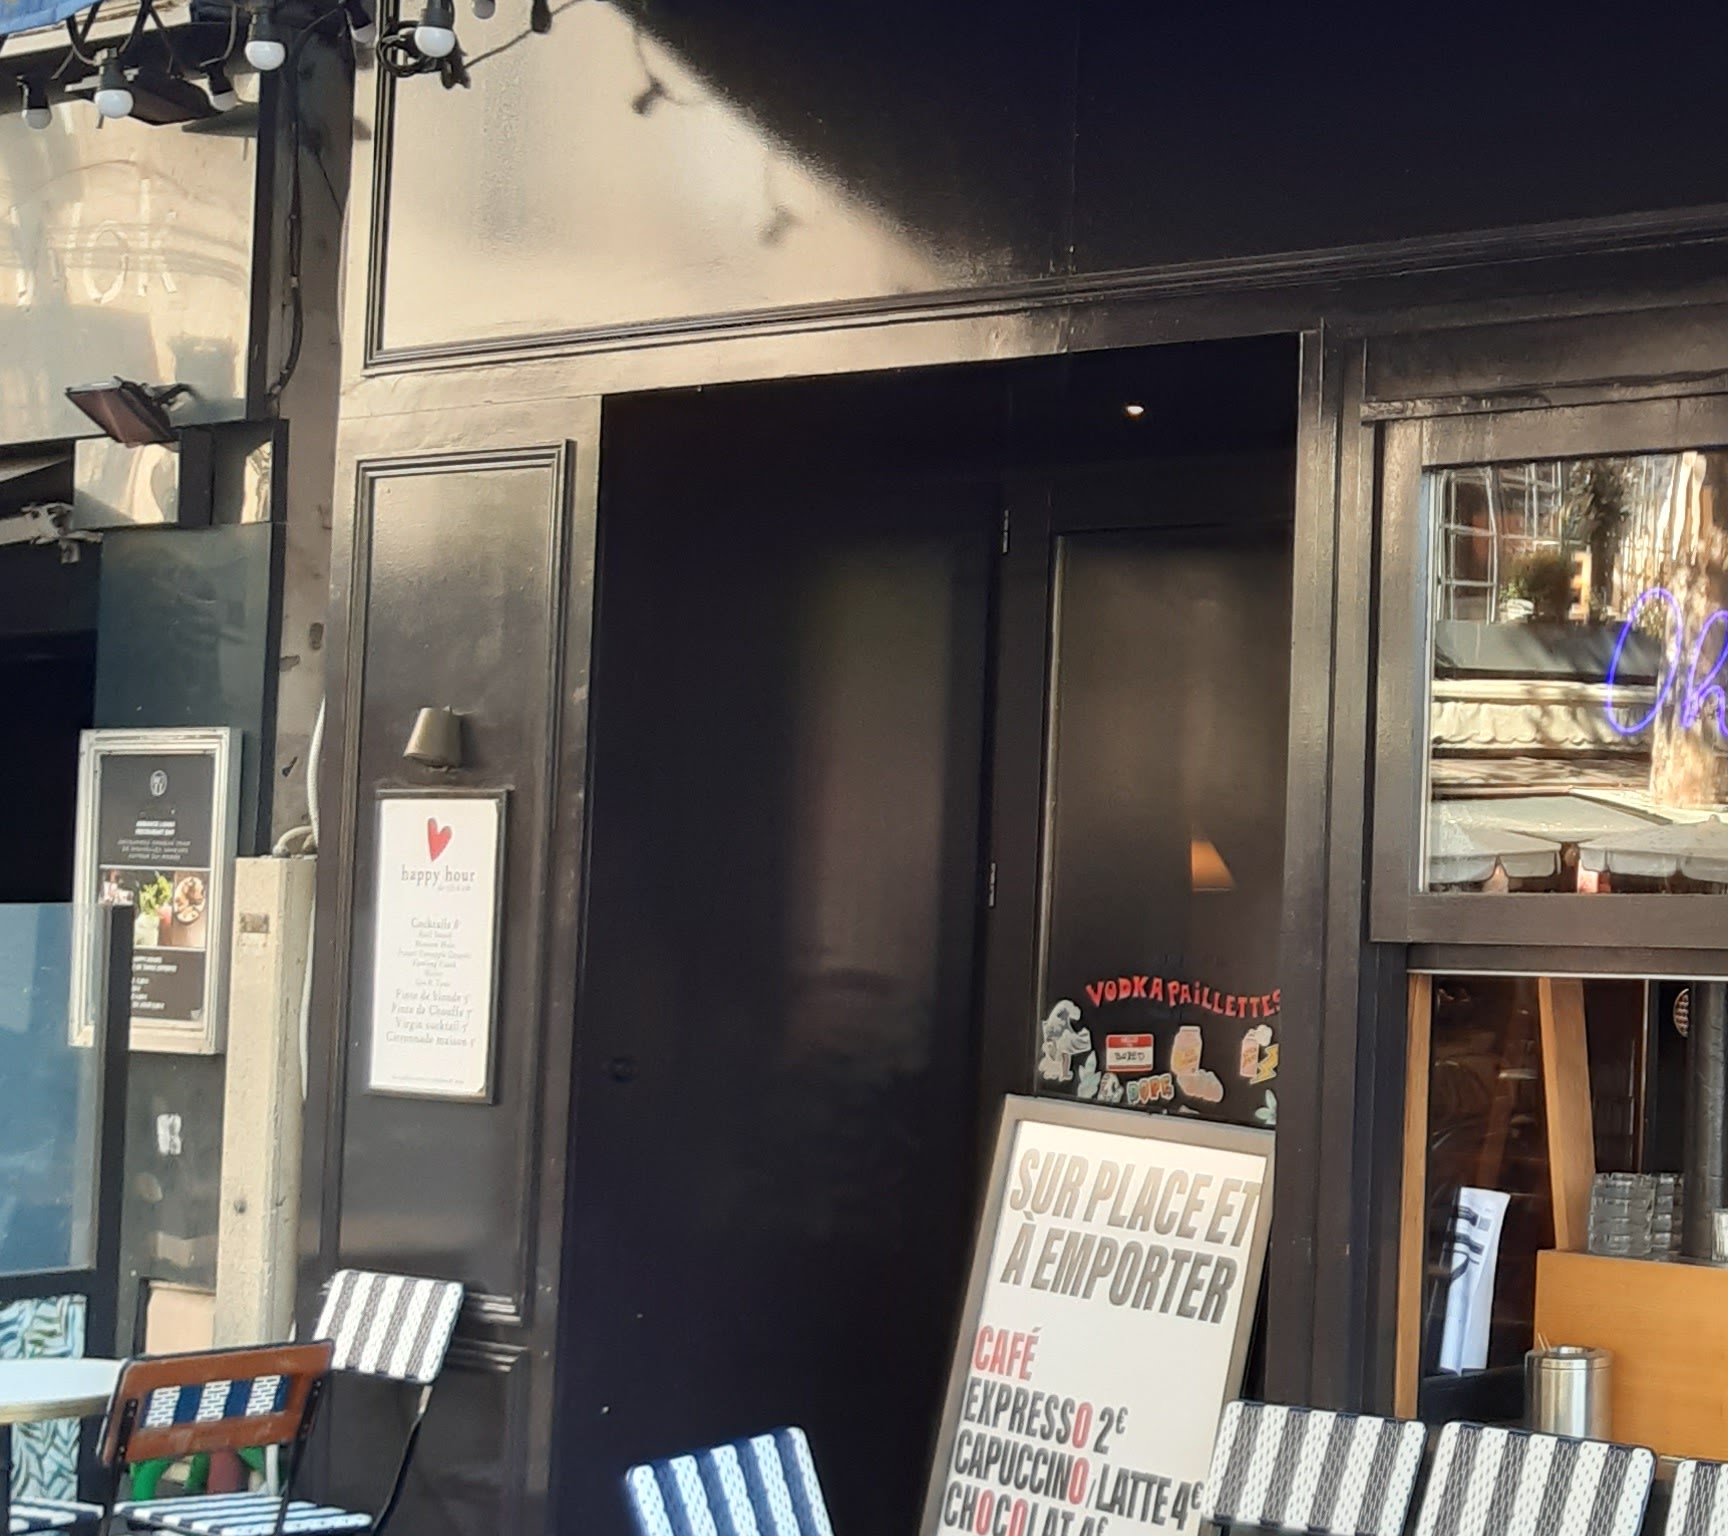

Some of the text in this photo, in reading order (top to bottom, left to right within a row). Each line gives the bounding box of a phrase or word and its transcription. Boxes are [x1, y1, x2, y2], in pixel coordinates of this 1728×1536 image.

[401, 865, 476, 886] happy hour
[1085, 975, 1163, 1007] VODKA
[1009, 1147, 1262, 1248] SUR PLACE ET
[1000, 1210, 1238, 1324] À EMPORTER
[973, 1324, 1043, 1382] CAFÉ
[963, 1376, 1129, 1455] EXPRESSO 2€
